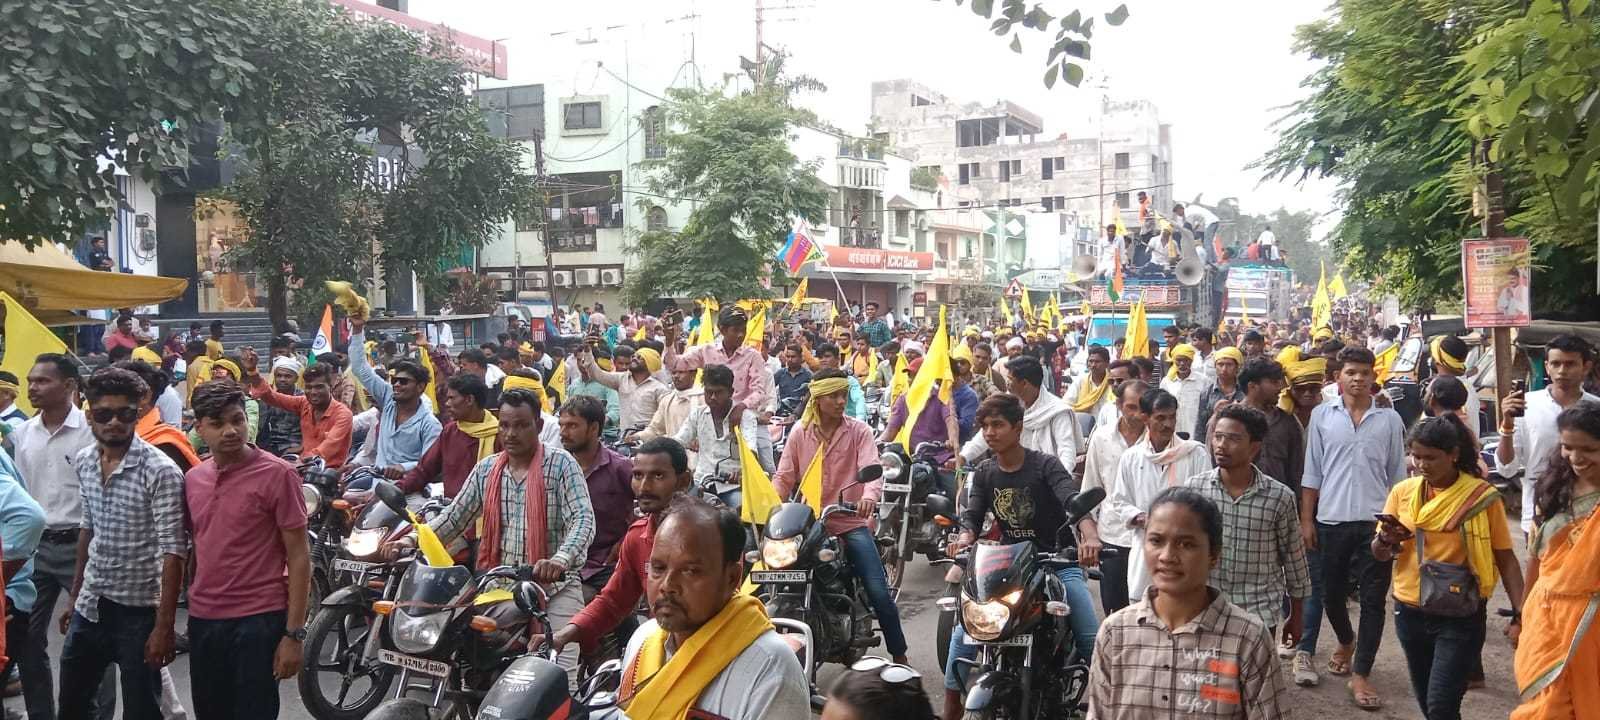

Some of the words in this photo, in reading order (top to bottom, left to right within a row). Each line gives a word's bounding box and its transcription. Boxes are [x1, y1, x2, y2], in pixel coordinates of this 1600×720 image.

[1006, 530, 1035, 538] TIGER
[1182, 647, 1221, 662] What
[1180, 673, 1217, 685] want
